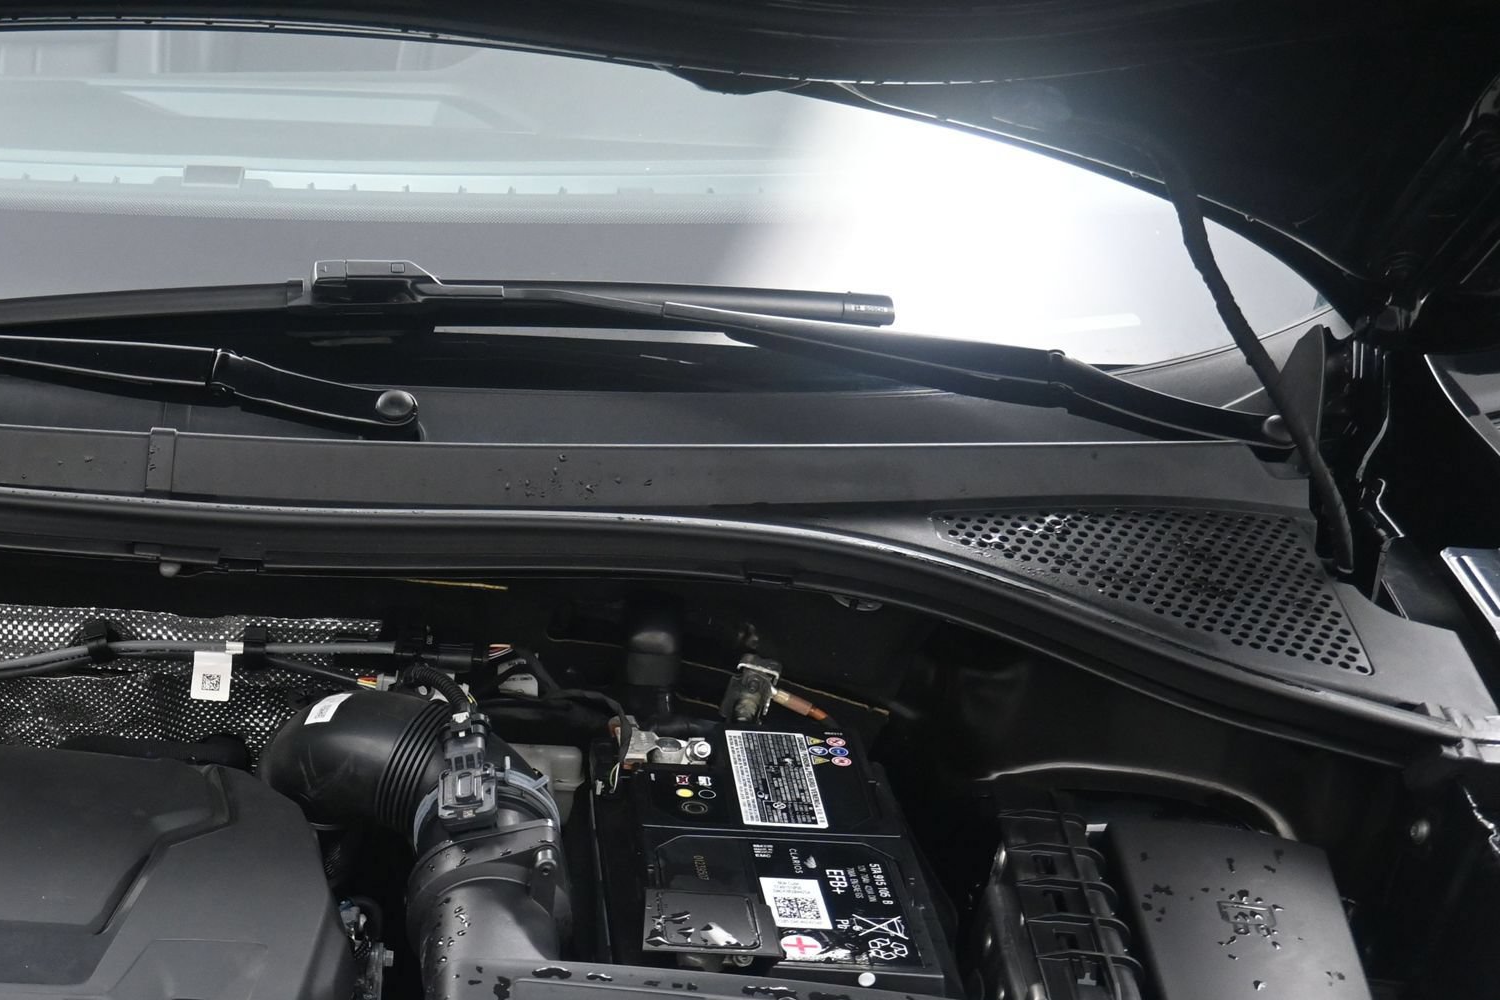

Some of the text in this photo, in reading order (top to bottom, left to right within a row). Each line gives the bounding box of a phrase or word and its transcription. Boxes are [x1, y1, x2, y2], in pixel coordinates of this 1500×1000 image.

[789, 848, 803, 874] CLARIOS
[869, 863, 882, 874] 5TA
[825, 869, 848, 895] EFB+
[873, 874, 887, 886] 915
[878, 886, 891, 898] 105
[835, 919, 851, 930] Pb
